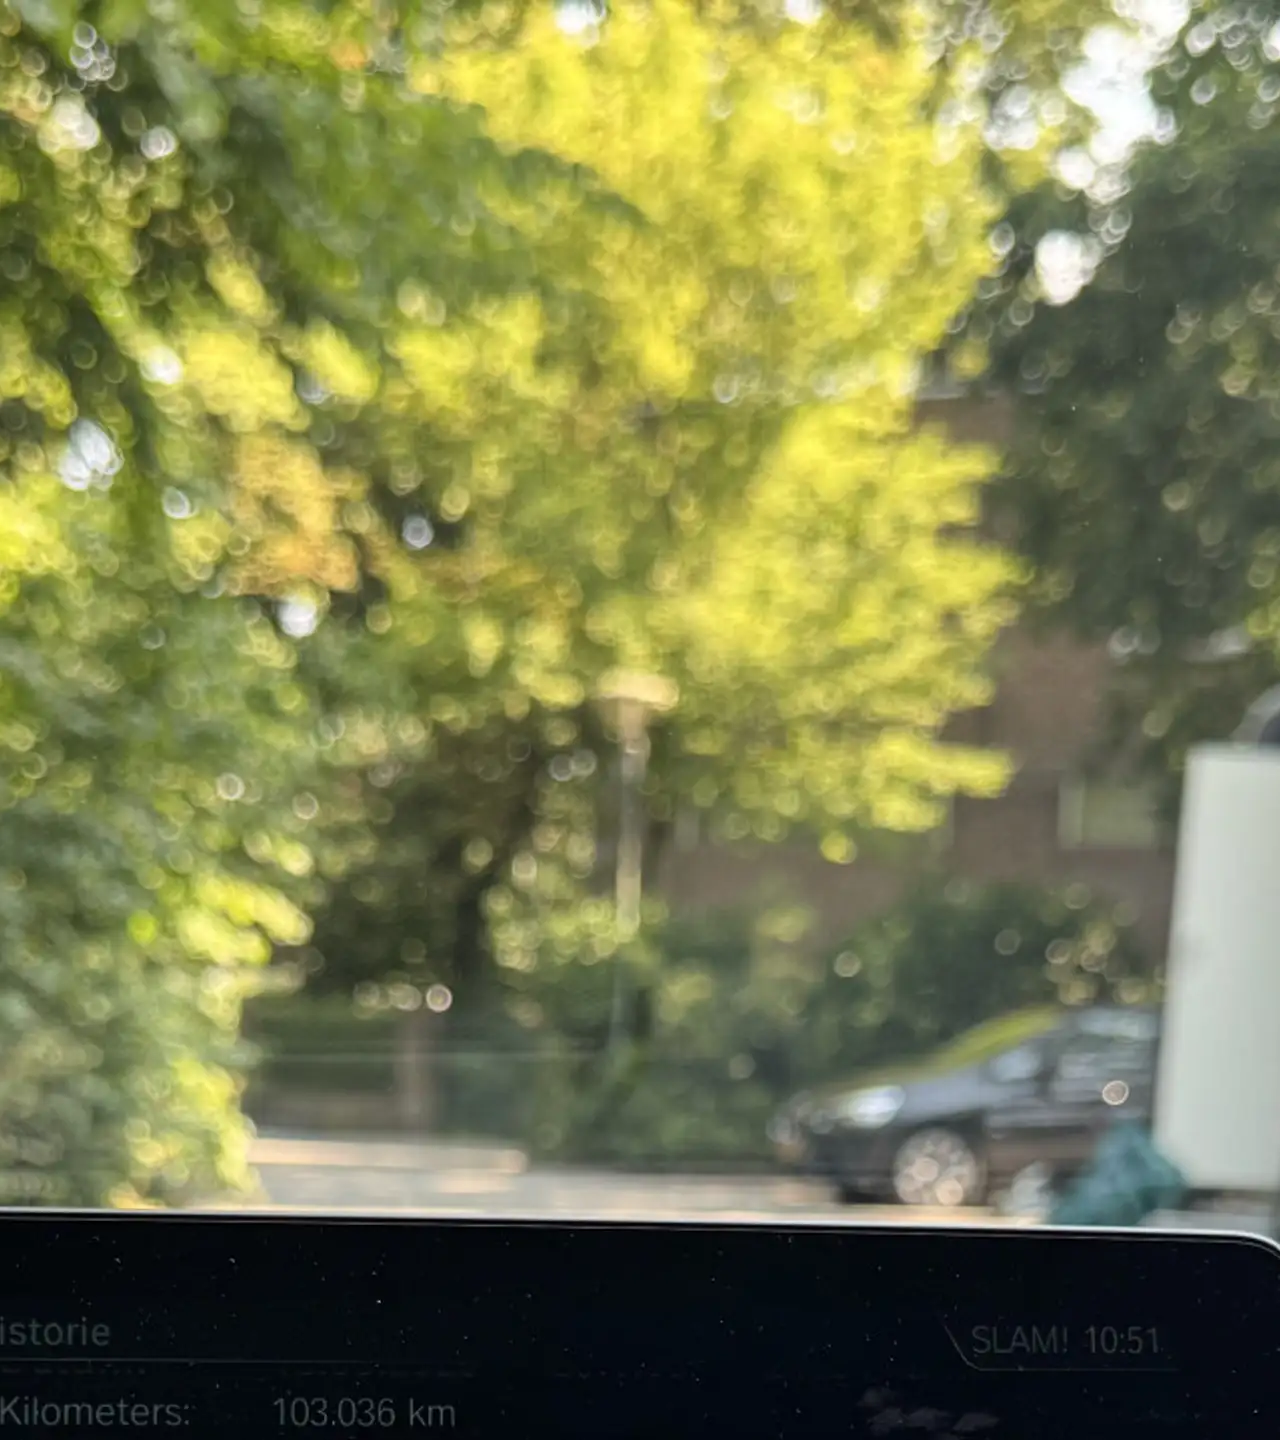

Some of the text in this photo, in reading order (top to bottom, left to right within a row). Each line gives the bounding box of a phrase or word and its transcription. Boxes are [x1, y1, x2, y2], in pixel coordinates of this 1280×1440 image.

[971, 1324, 1159, 1354] SLAM! 10:51
[0, 1395, 456, 1427] Kilometers: 103.036 km
